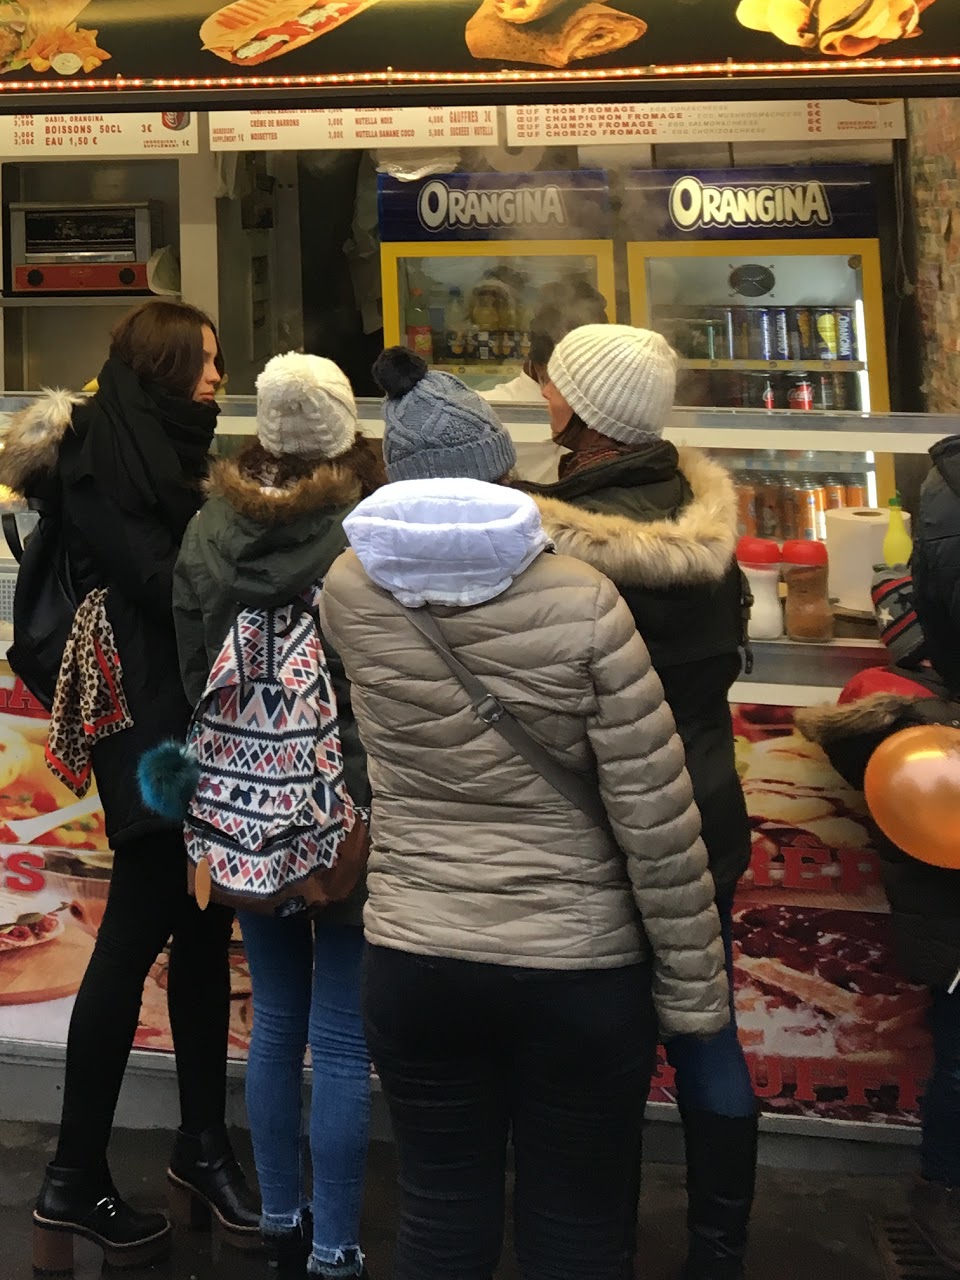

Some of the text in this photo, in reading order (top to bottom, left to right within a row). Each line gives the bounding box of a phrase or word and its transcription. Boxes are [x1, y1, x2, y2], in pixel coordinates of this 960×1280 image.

[545, 114, 622, 122] CHAMPIGNON
[45, 124, 152, 134] BOISSONS 50CL 3€
[401, 129, 415, 137] COCO
[603, 128, 657, 136] FROMAGE
[45, 137, 63, 146] EAU
[69, 137, 88, 147] 1,50
[419, 179, 566, 230] ORANGINA
[672, 176, 830, 229] ORANGINA
